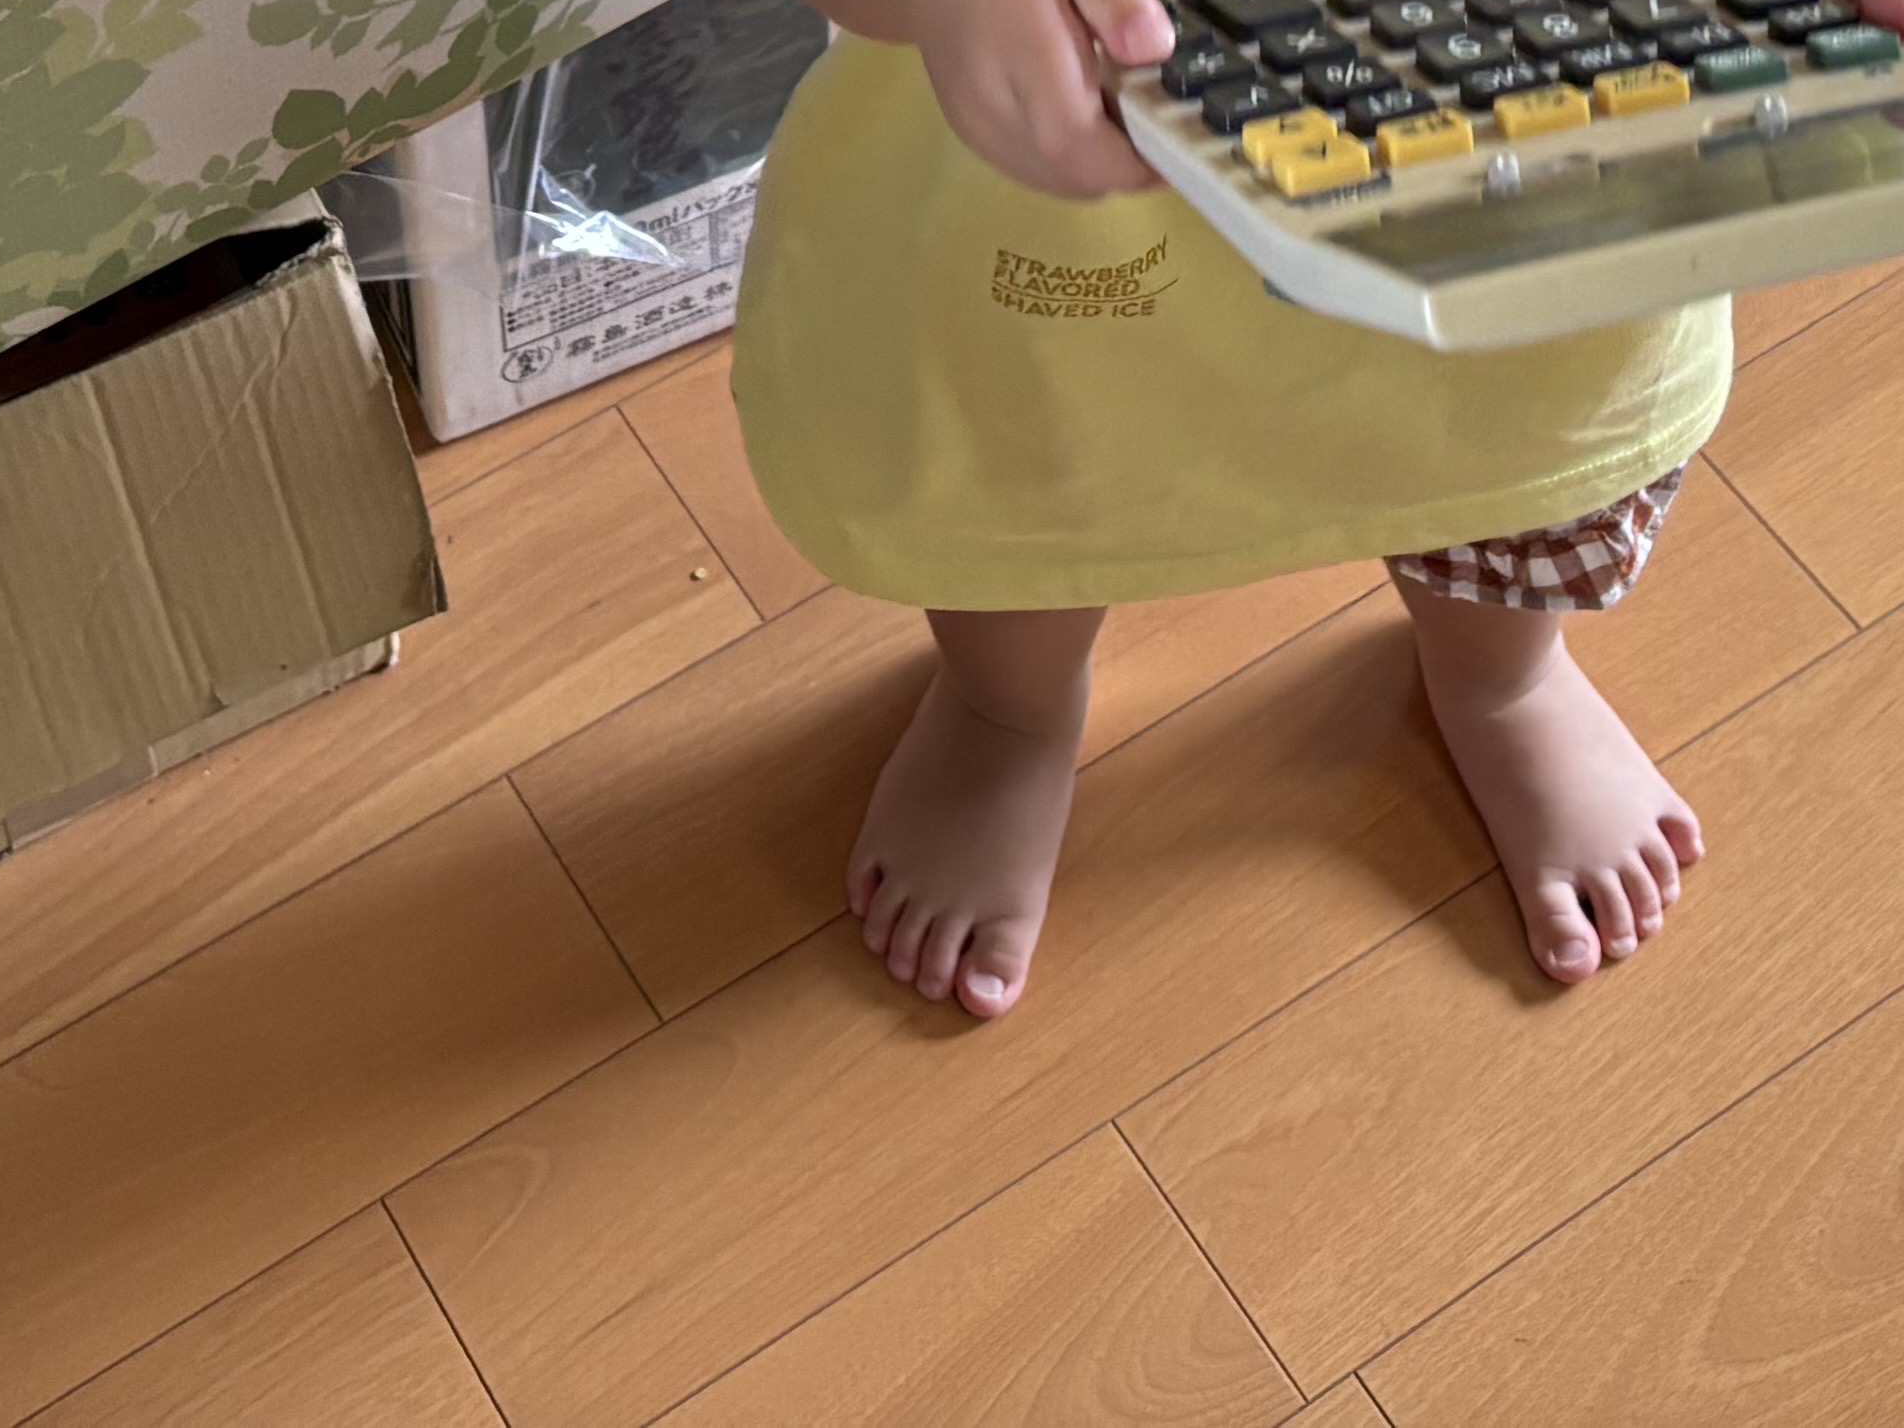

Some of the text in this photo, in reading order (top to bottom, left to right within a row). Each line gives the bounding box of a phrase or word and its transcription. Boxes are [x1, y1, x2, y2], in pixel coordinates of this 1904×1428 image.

[997, 232, 1168, 283] STRAWBERRY
[993, 264, 1141, 299] FLAVORED
[991, 286, 1156, 318] SHAVED ICE
